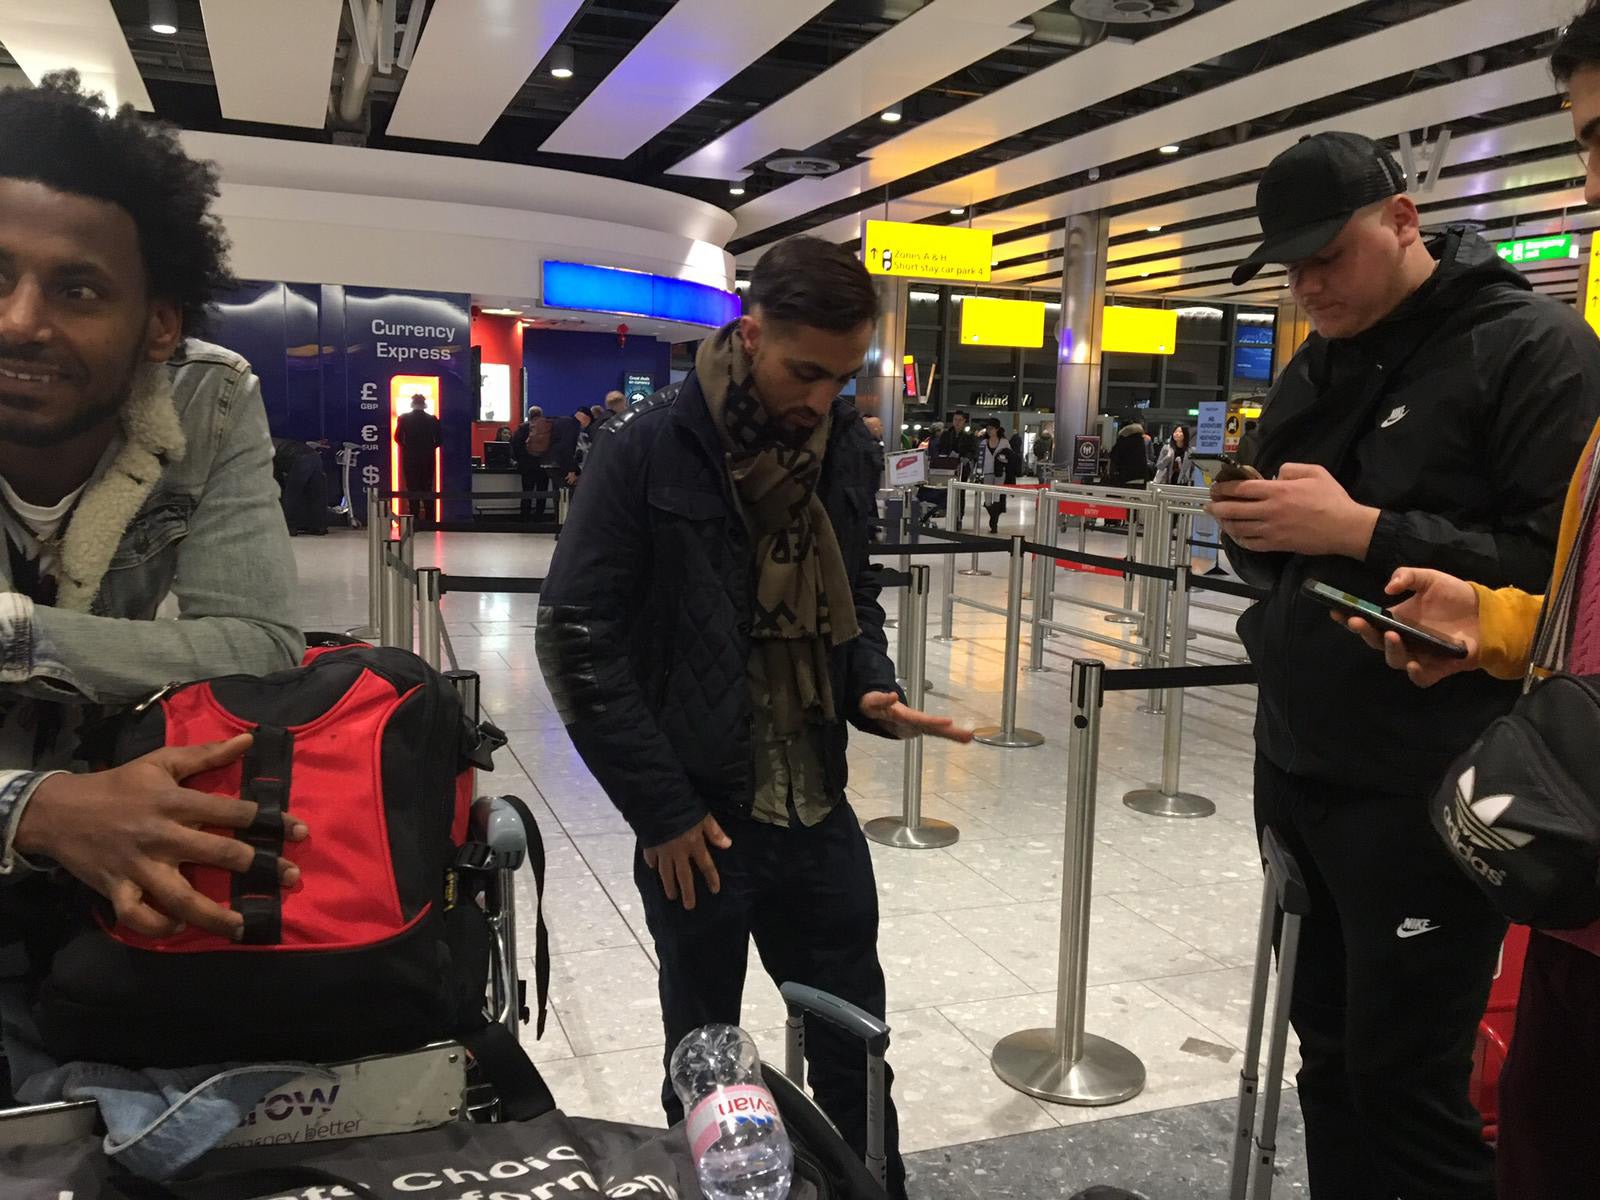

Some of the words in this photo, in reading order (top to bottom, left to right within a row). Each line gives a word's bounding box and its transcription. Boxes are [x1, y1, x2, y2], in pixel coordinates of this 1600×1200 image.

[923, 252, 930, 260] A
[894, 261, 919, 271] Short
[920, 264, 939, 274] stay
[941, 266, 954, 274] car
[956, 267, 976, 276] park
[371, 319, 456, 343] Currency
[376, 341, 452, 362] Express
[360, 382, 378, 401] £
[361, 424, 379, 442] €
[362, 464, 380, 486] $
[1443, 805, 1504, 886] adidas
[1402, 917, 1431, 931] NIKE
[304, 1118, 362, 1141] better
